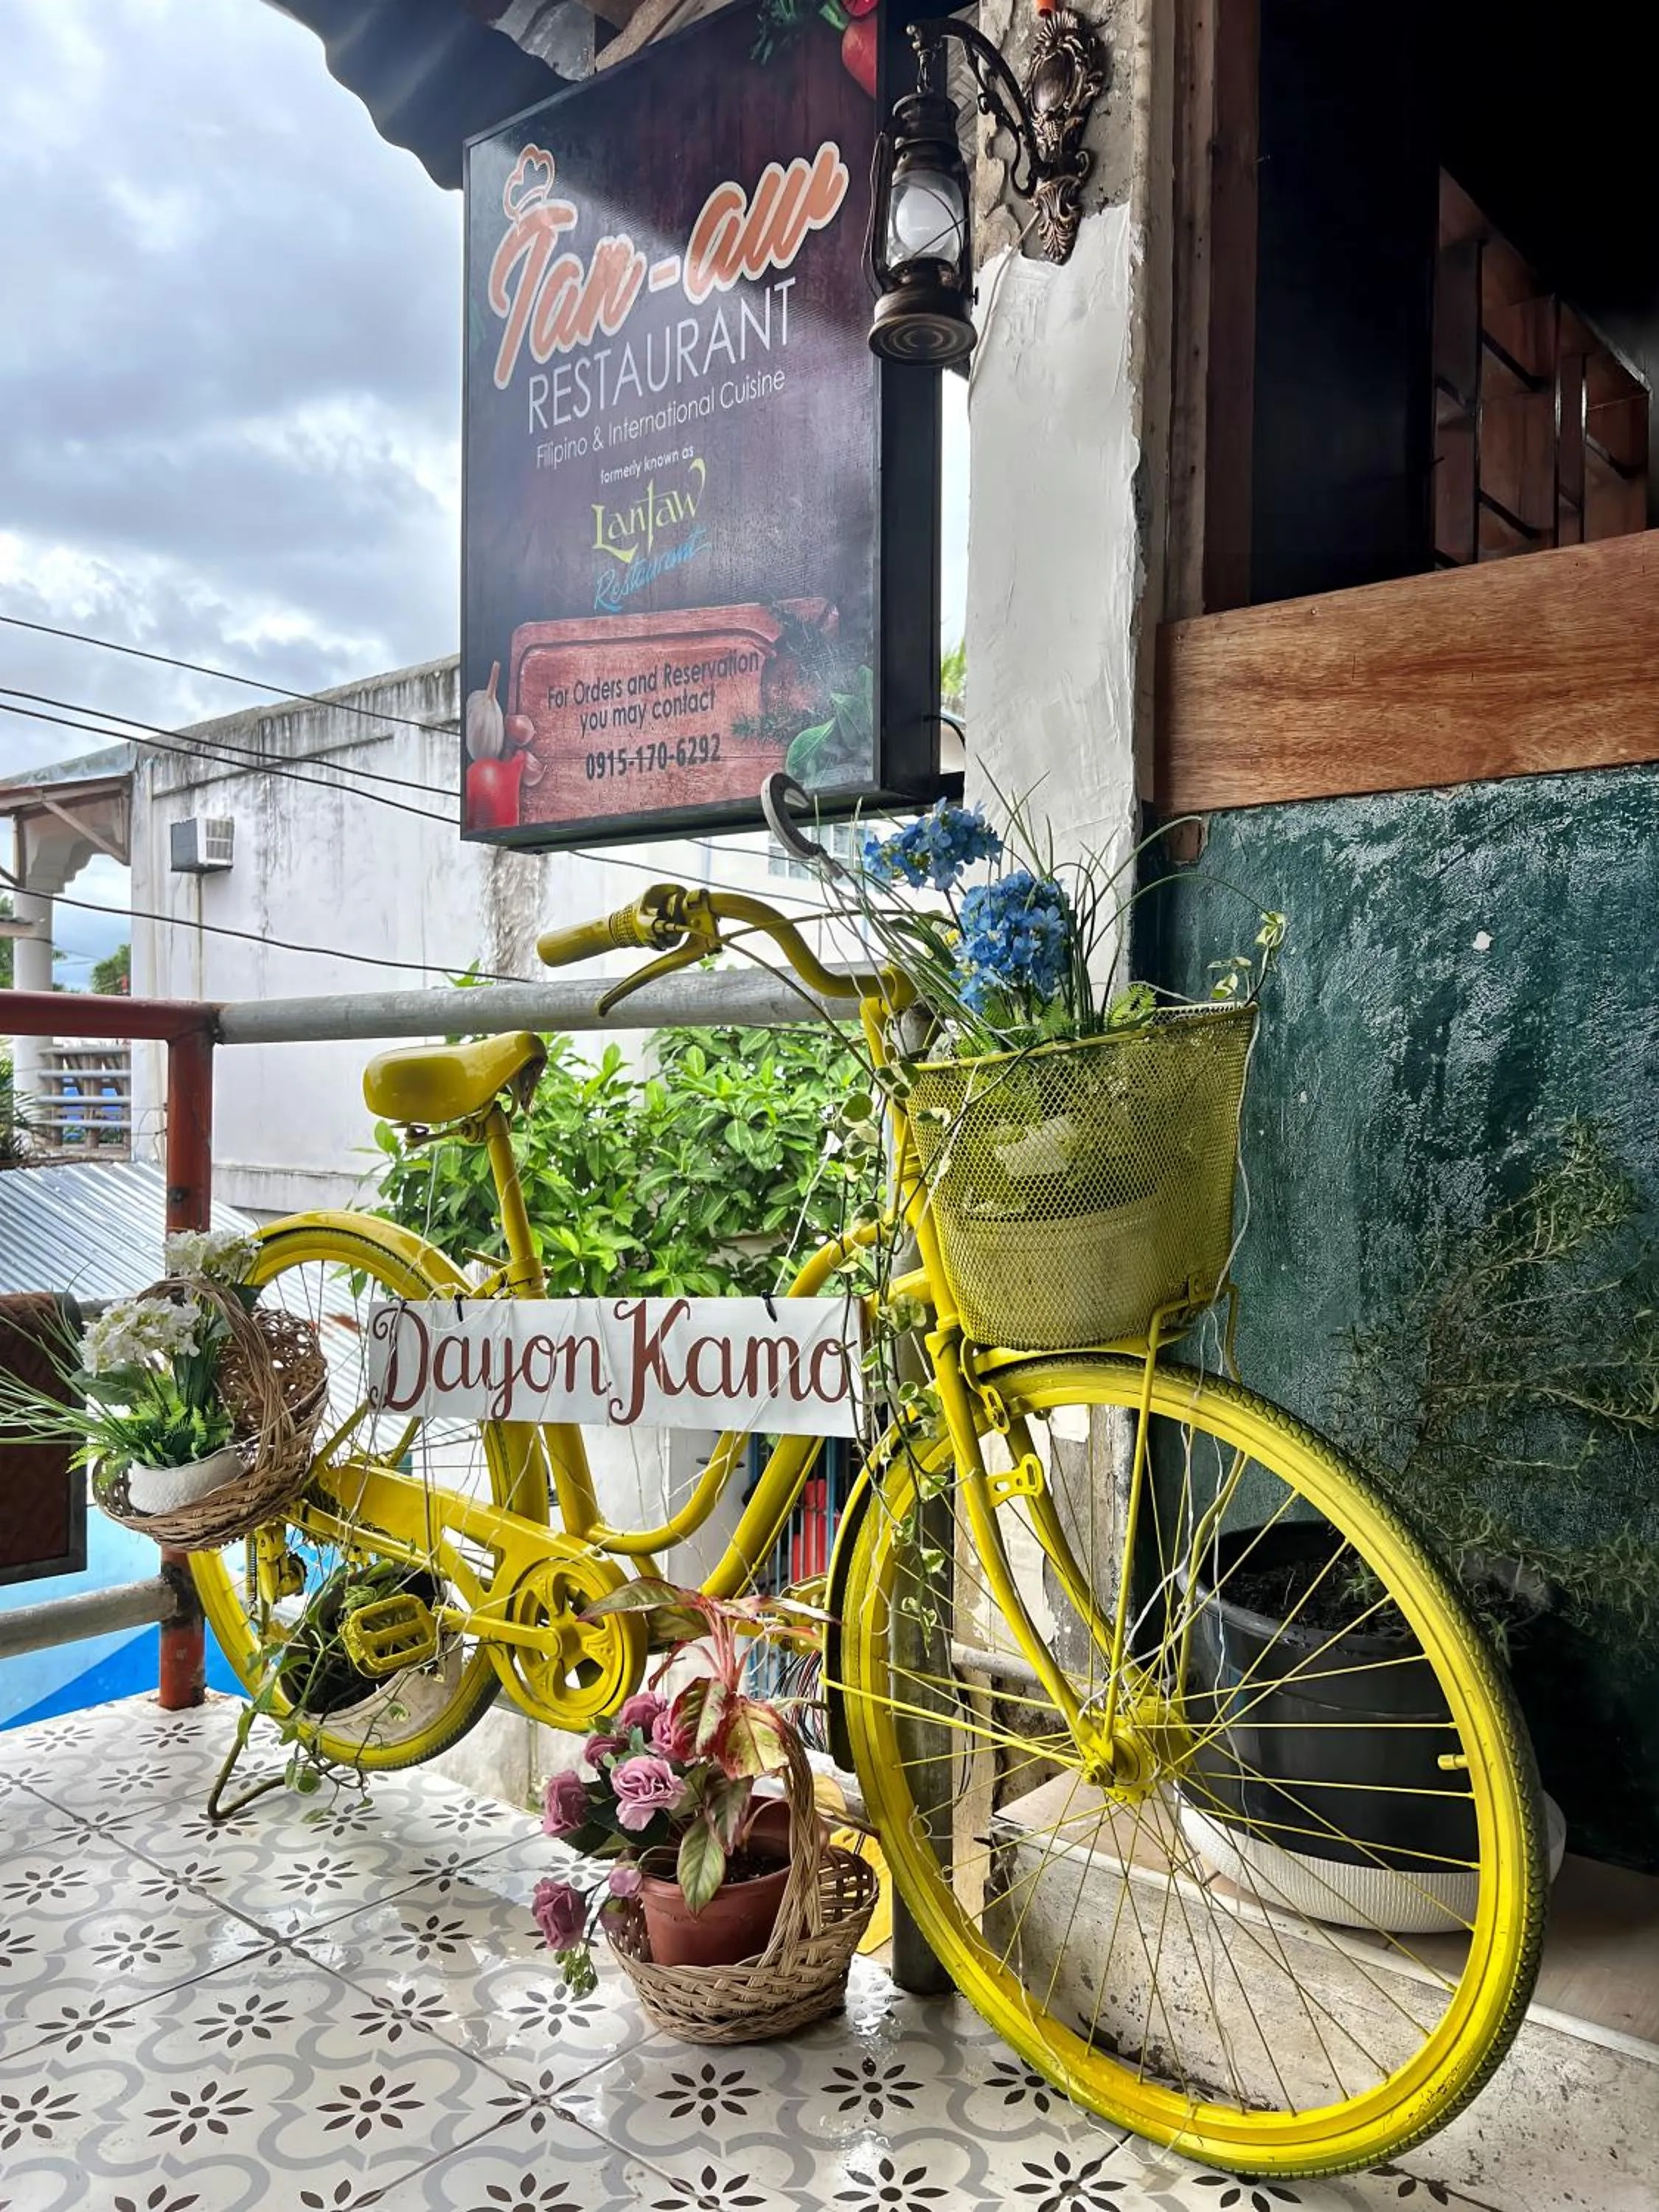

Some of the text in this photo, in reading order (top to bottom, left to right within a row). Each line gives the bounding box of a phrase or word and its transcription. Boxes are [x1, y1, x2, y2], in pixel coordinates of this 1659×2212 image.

[528, 277, 796, 434] RESTAURANT
[536, 369, 786, 470] Filipino & International Cuisine
[600, 445, 695, 484] formerly known as
[591, 457, 706, 563] Lantaw
[548, 650, 759, 709] For Orders and Reservation
[580, 687, 716, 738] you may contact
[585, 733, 721, 780] 0915-170-6292
[370, 1298, 858, 1426] Dayon Kamo
